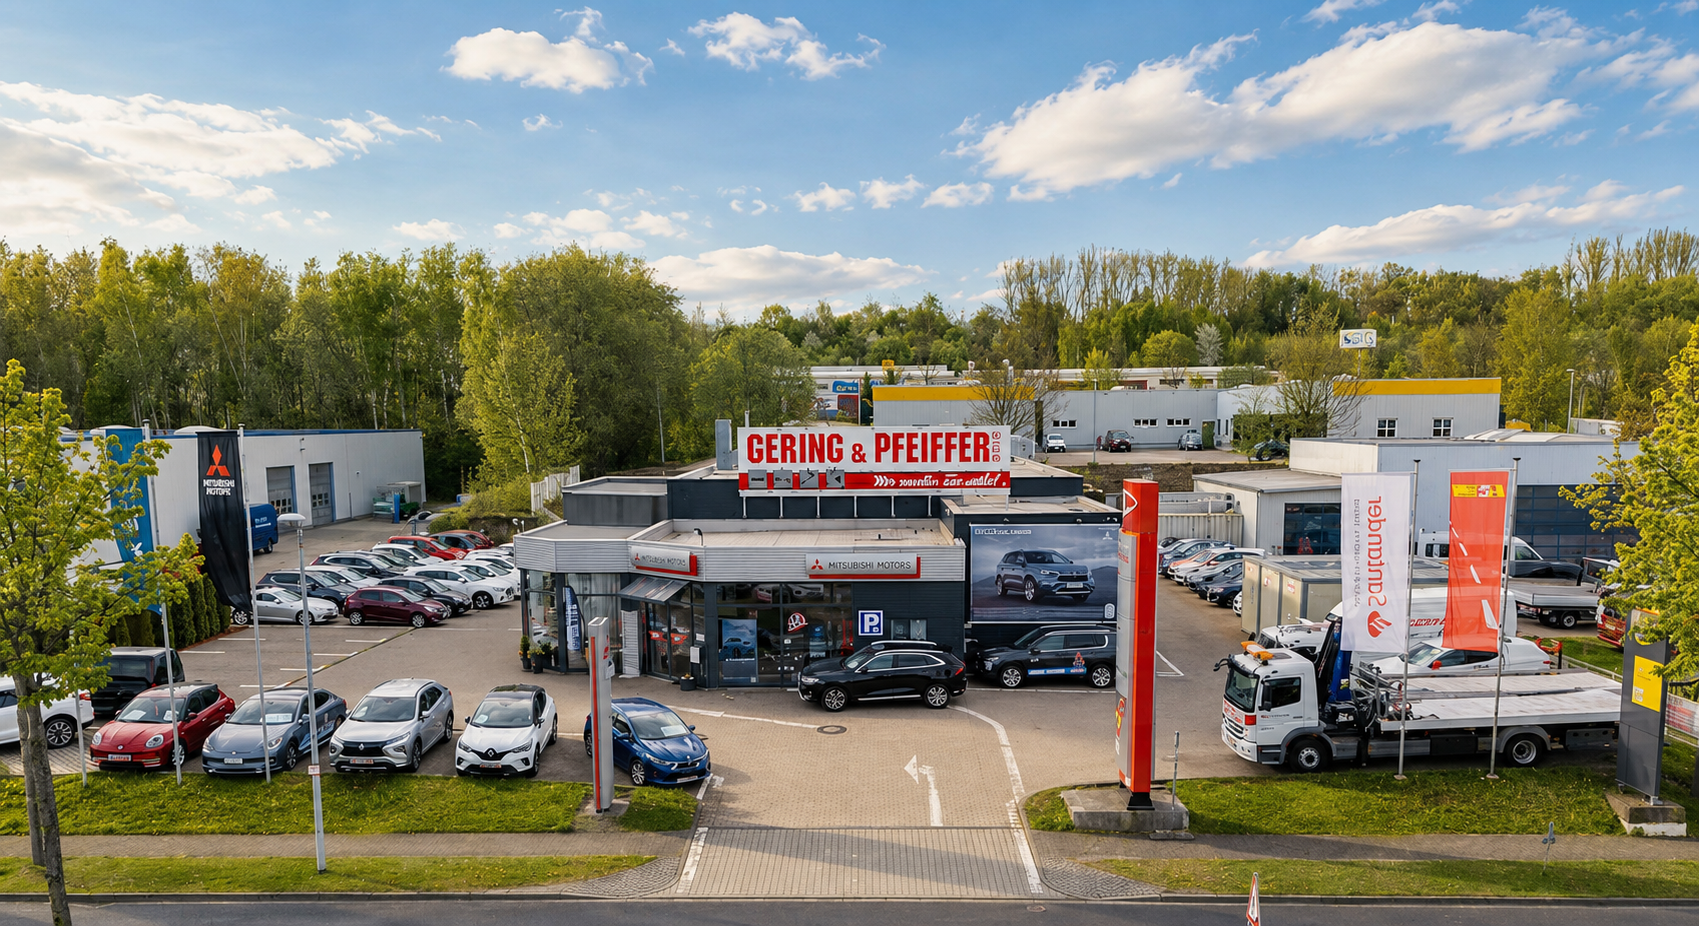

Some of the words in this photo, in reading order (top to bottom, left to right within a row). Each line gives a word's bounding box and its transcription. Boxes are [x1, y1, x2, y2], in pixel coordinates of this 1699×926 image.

[747, 433, 844, 463] GERING
[851, 443, 867, 463] &
[875, 432, 990, 463] PFEIFFER
[828, 561, 874, 570] MITSUBISHI
[877, 561, 912, 570] MOTORS
